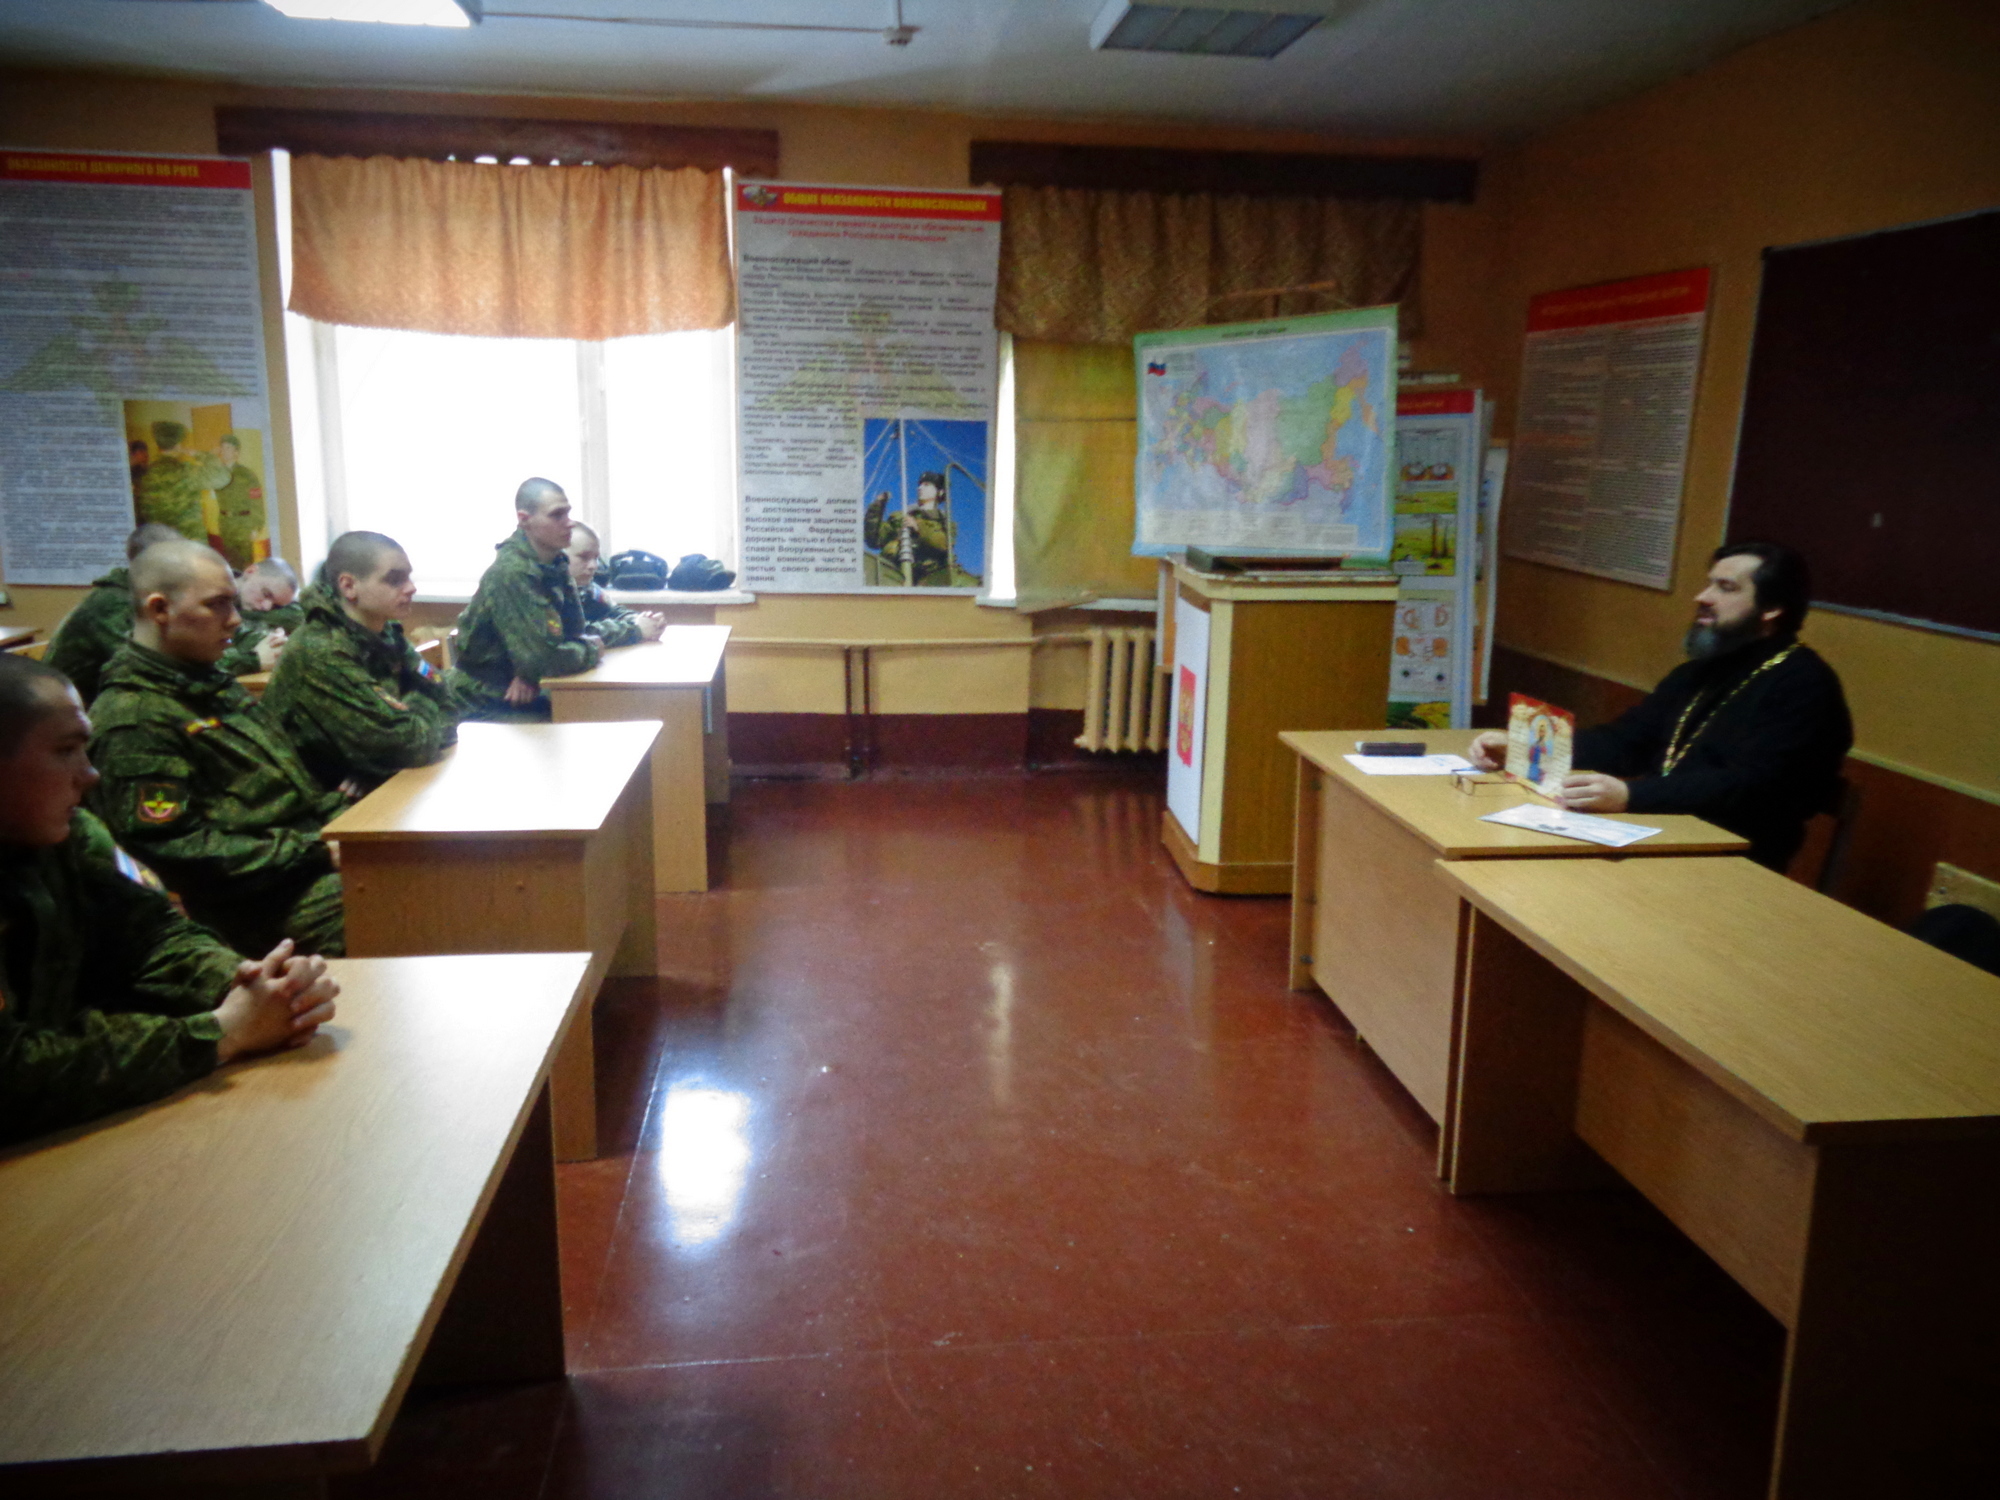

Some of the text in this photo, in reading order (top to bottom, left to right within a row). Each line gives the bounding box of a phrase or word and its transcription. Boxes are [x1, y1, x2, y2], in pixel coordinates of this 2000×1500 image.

[745, 495, 818, 505] Военнослужащий
[745, 525, 794, 533] Российской
[778, 545, 835, 554] Вооруженных
